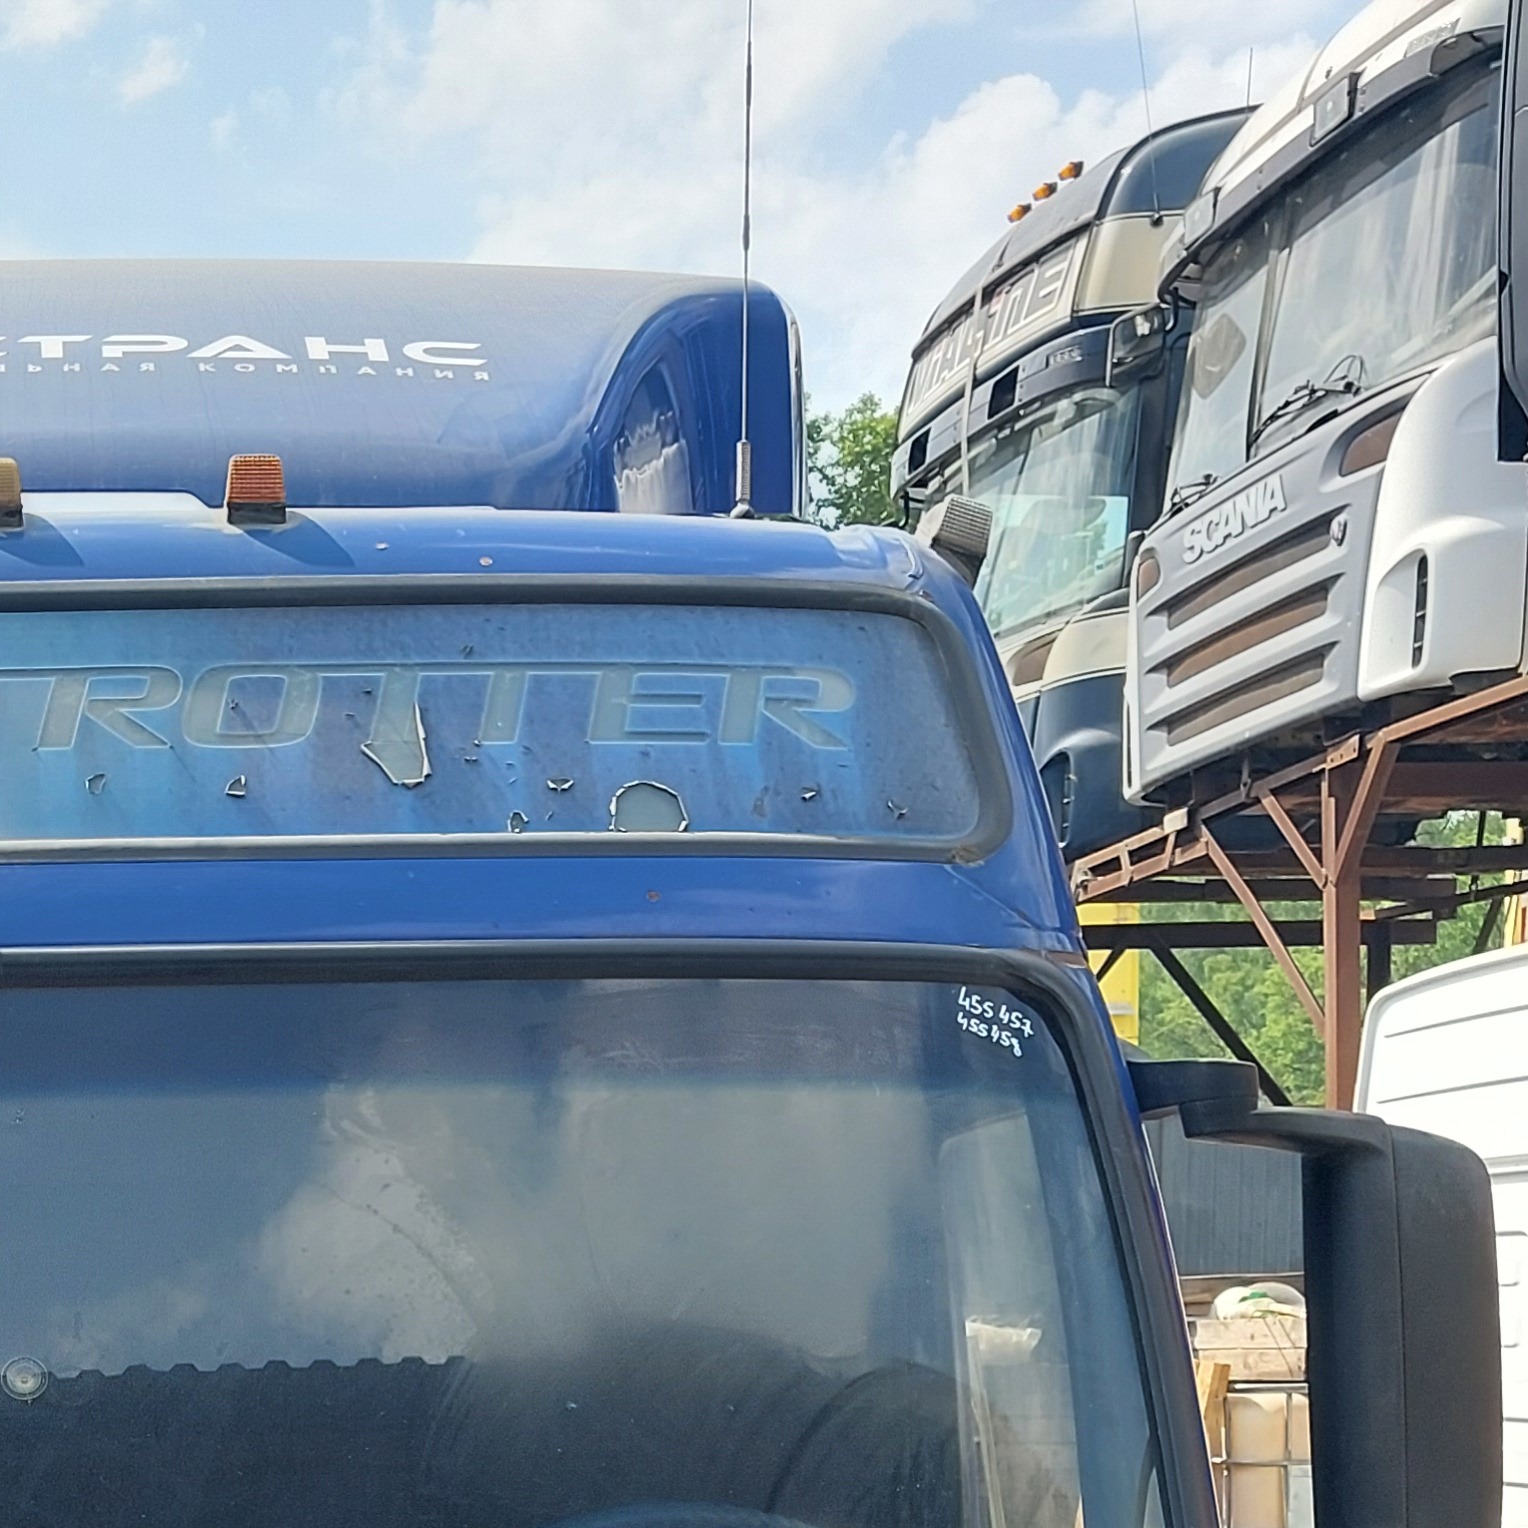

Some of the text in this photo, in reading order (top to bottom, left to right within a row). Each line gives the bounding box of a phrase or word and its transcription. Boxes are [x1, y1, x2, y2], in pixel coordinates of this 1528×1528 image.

[197, 362, 491, 382] КОМПАНИЯ
[1182, 473, 1288, 564] SCANIA
[956, 1011, 989, 1038] 455
[958, 985, 1035, 1039] 455 457
